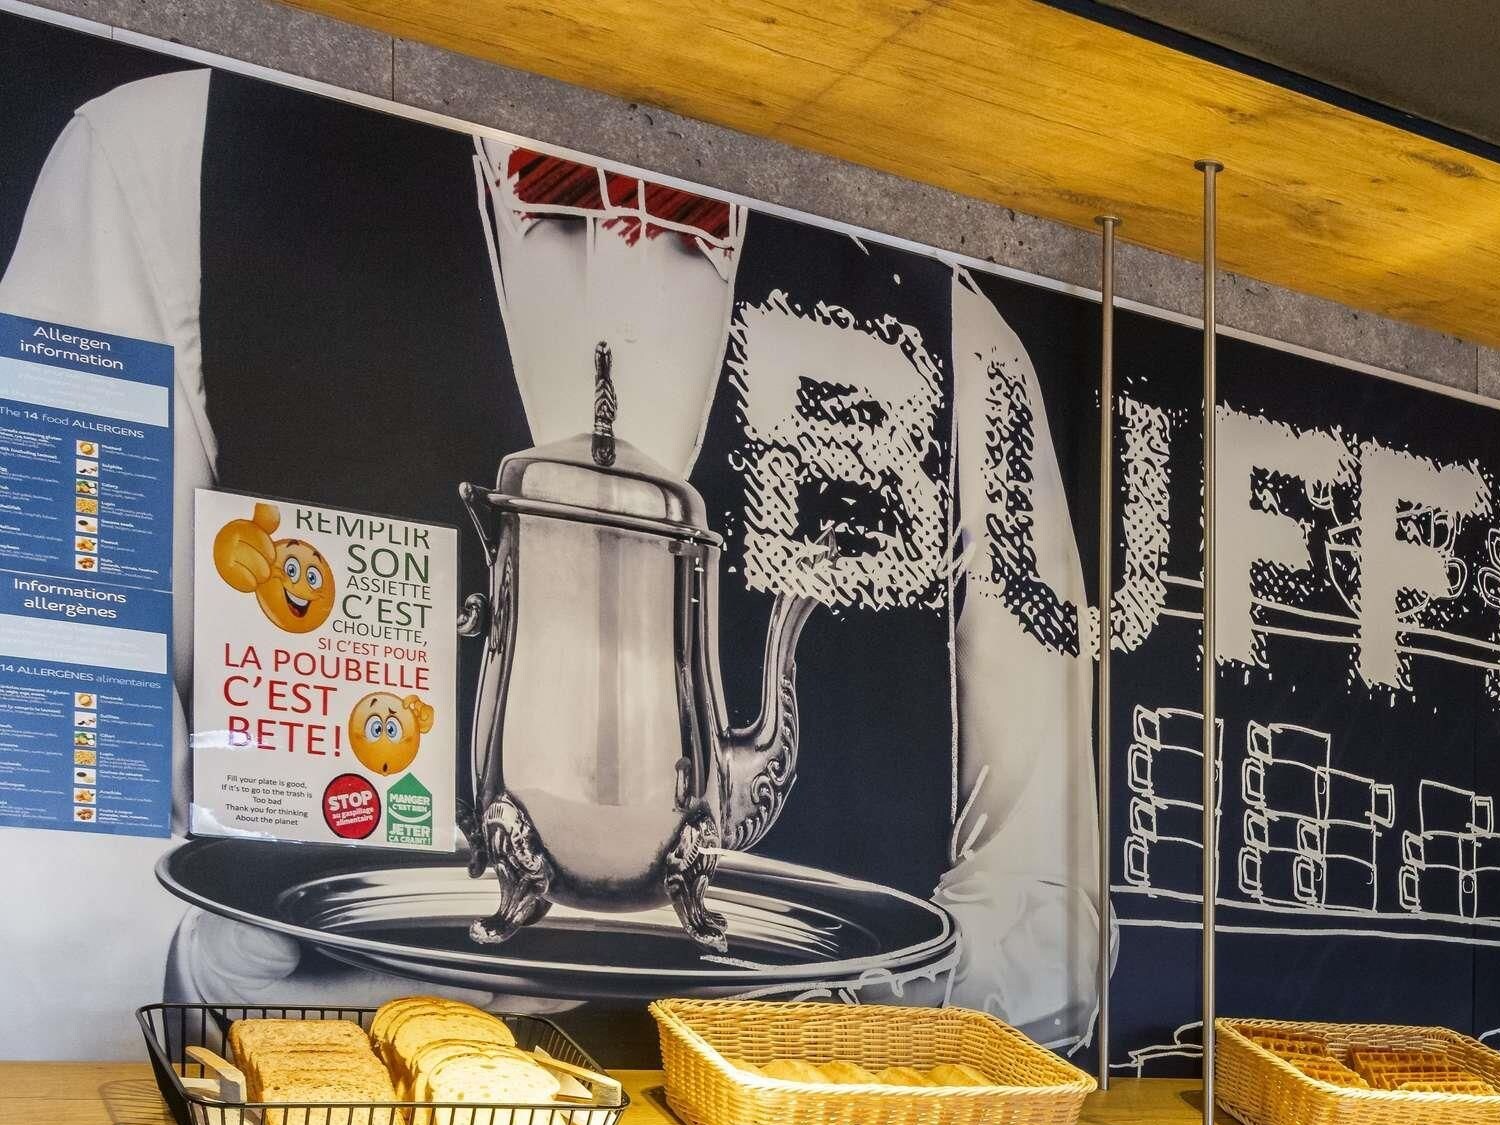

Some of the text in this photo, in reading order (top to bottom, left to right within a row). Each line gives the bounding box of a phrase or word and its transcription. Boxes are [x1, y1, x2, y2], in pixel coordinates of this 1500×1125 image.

[33, 326, 111, 351] Allergen
[20, 340, 124, 370] information
[24, 410, 39, 420] 14
[42, 413, 69, 425] food
[72, 419, 145, 439] ALLERGENS
[296, 508, 430, 549] REMPLIR
[347, 544, 429, 584] SON
[14, 578, 127, 603] Informations
[346, 575, 431, 600] ASSIETTE
[24, 596, 118, 619] allergènes
[342, 594, 433, 628] C'EST
[332, 619, 428, 647] CHOUETTE,
[318, 637, 428, 663] SI C'EST POUR
[0, 664, 14, 673] 14
[96, 675, 161, 689] alimentaires
[225, 643, 430, 691] LA POUBELLE
[223, 675, 338, 716] C'EST
[258, 778, 277, 786] plate
[272, 789, 284, 797] the
[286, 790, 305, 798] trash
[225, 804, 248, 812] Thank
[279, 809, 309, 818] thinking
[328, 790, 373, 811] STOP
[390, 793, 430, 805] MANGER
[236, 815, 298, 826] About the planet
[336, 814, 373, 826] alimentaire
[389, 823, 430, 837] JETER
